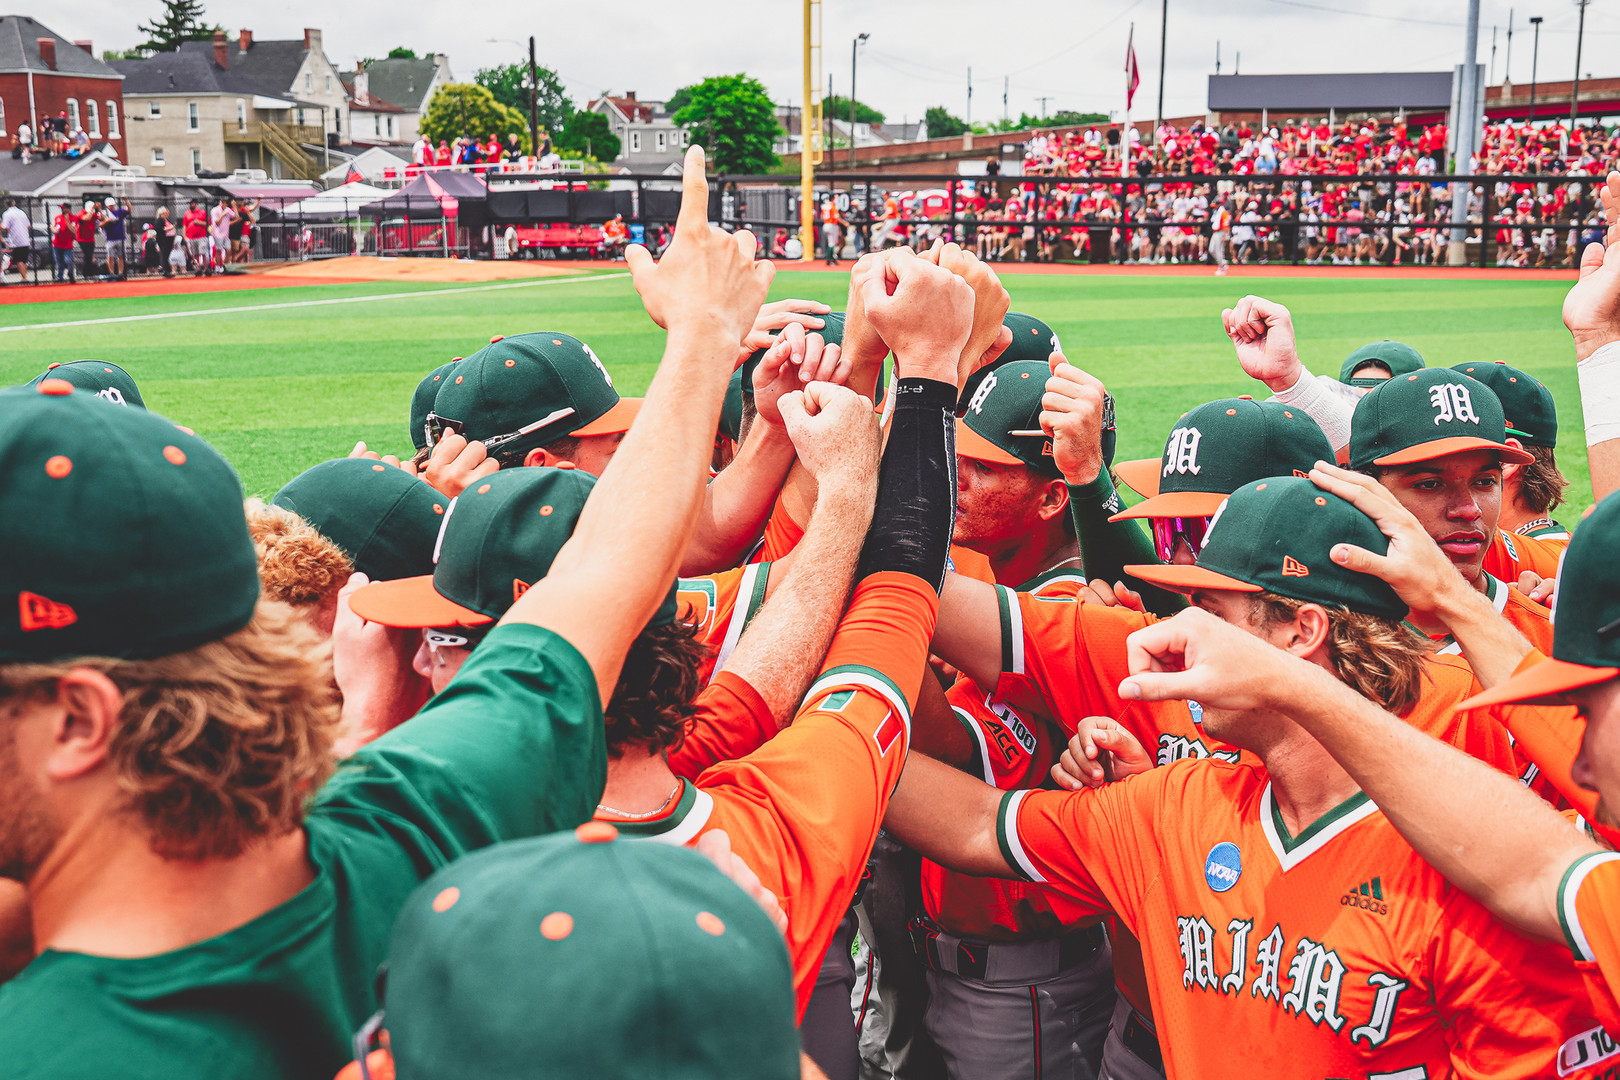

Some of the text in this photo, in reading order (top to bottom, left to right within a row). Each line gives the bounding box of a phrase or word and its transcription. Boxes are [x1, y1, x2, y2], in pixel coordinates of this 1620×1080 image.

[1429, 383, 1480, 426] M
[1163, 426, 1202, 478] M
[984, 720, 1020, 762] ACC
[1207, 861, 1239, 883] NCAA
[1340, 894, 1388, 916] adidas
[1177, 914, 1411, 1051] MIAMI
